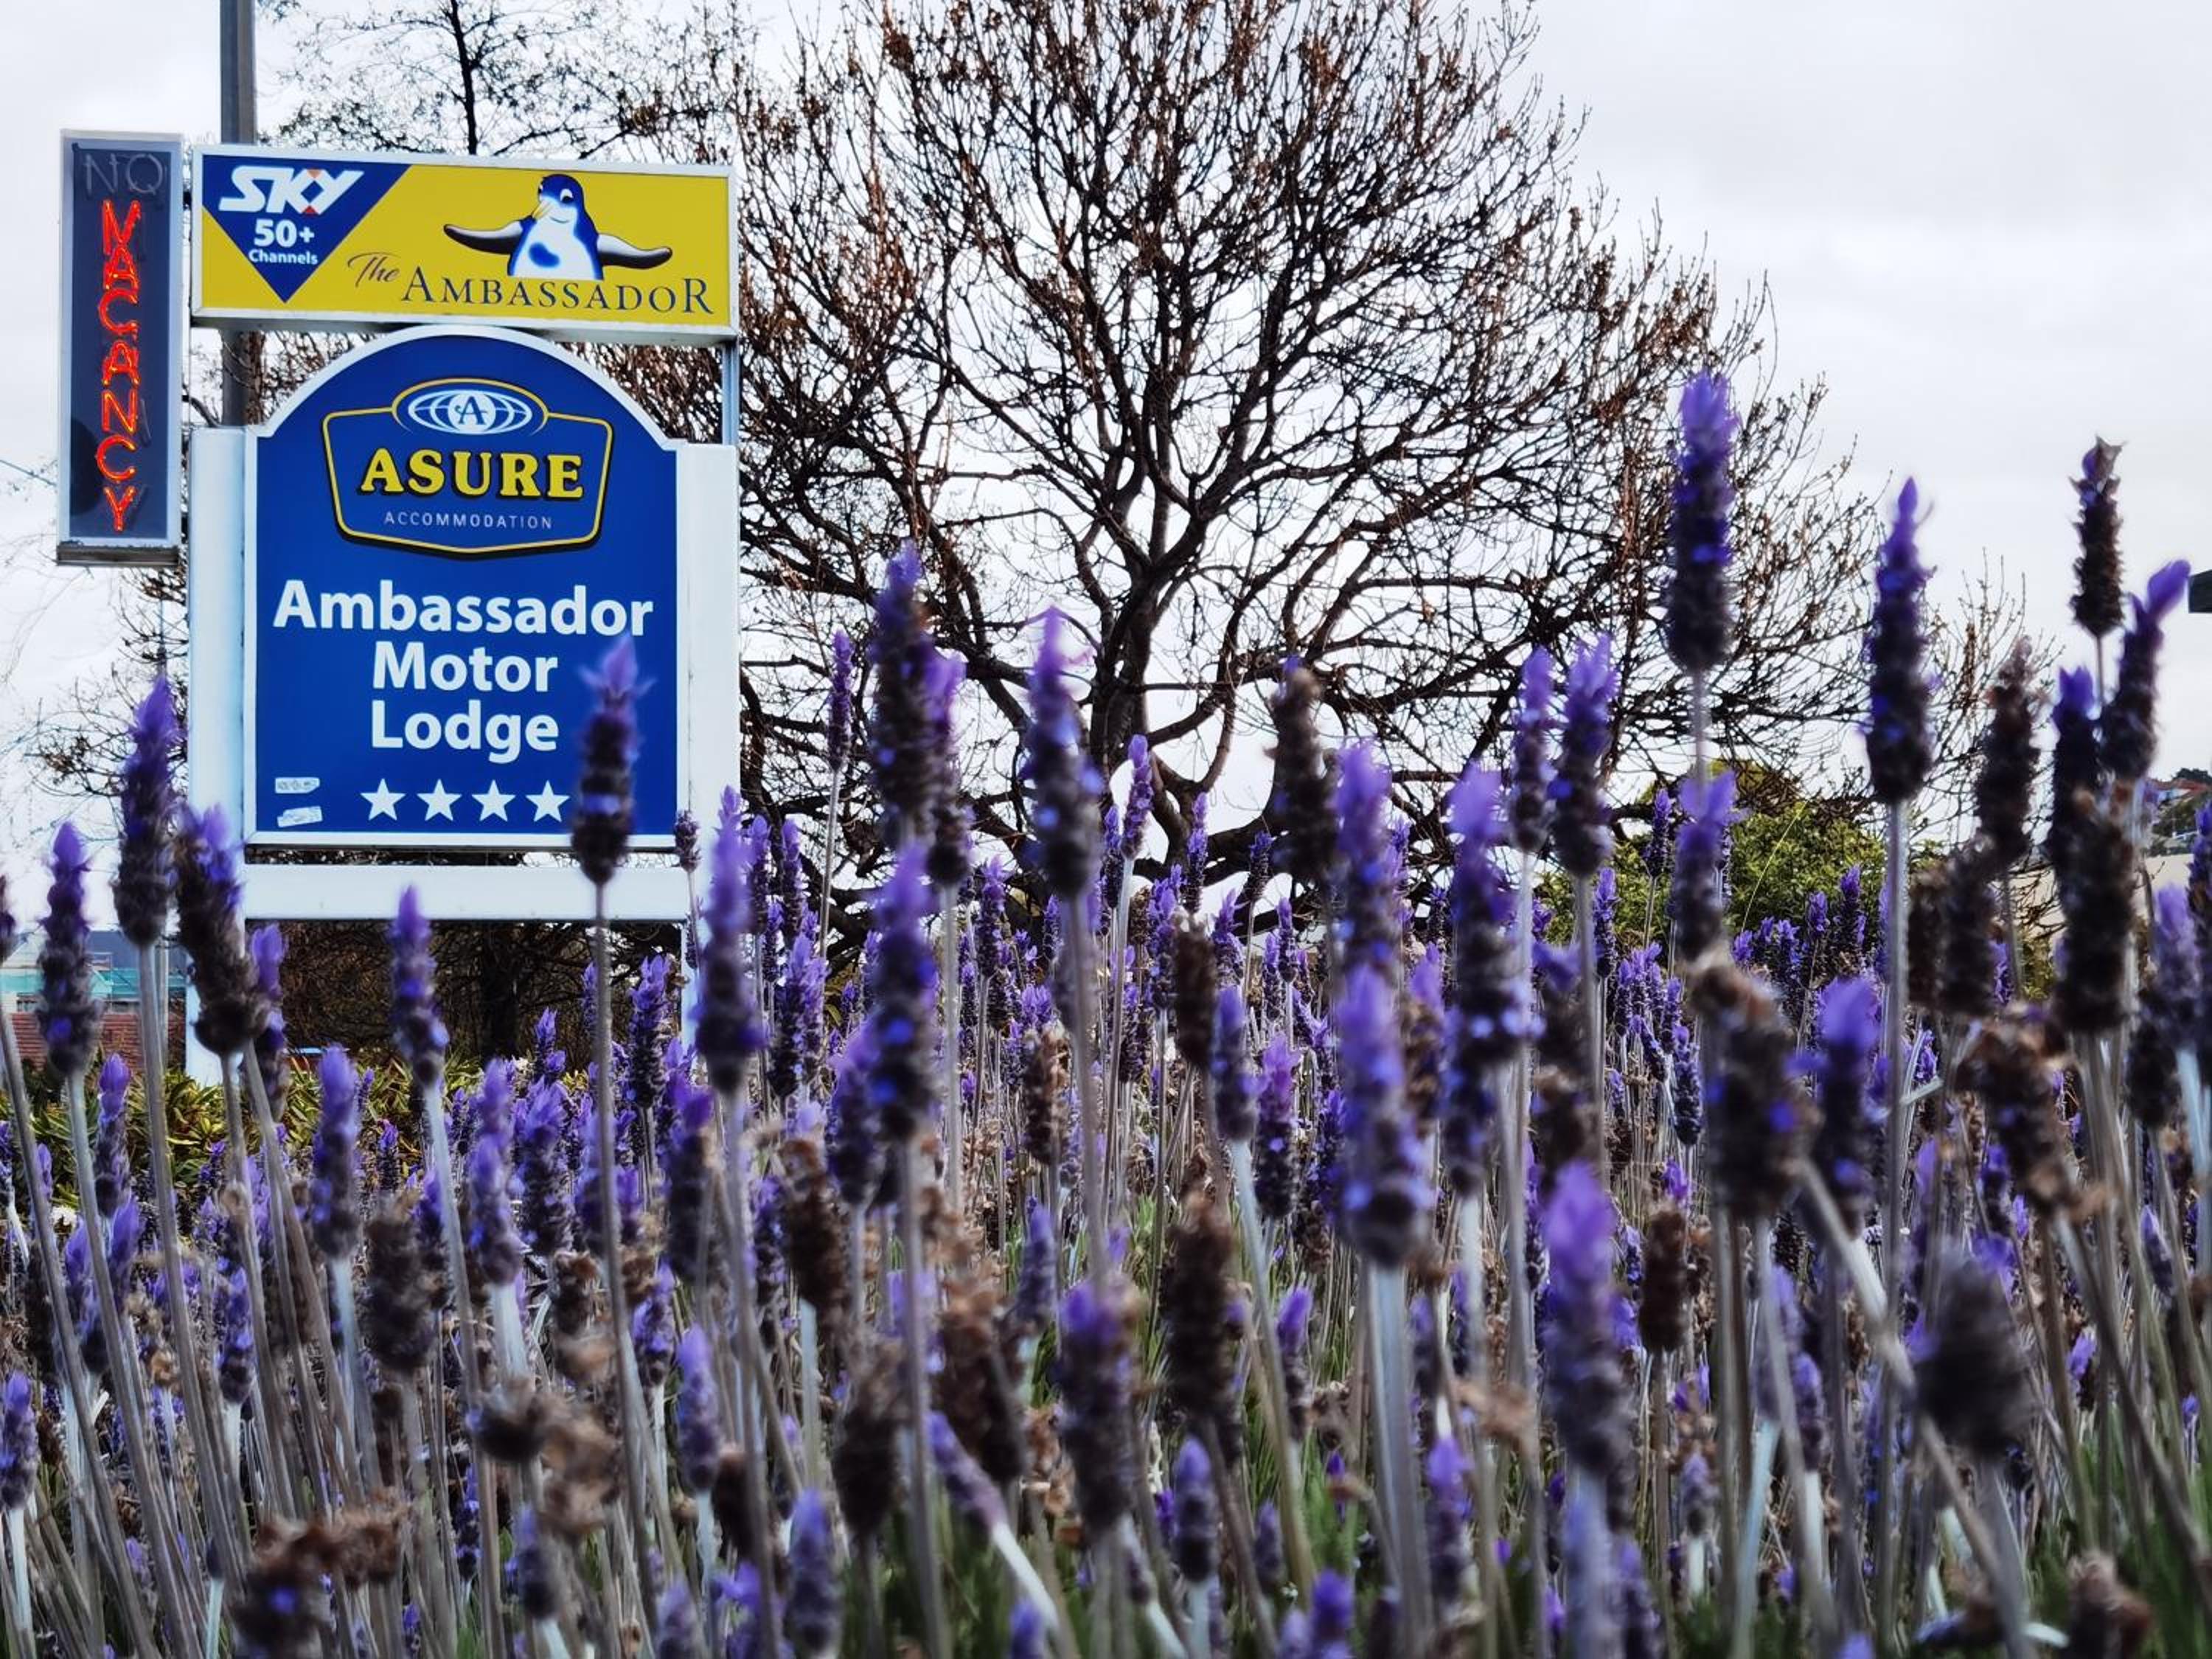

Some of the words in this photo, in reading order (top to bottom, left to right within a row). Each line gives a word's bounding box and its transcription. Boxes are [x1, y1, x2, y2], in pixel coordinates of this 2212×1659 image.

[83, 153, 164, 195] NO
[219, 166, 364, 215] SKY
[248, 248, 319, 265] Channels
[254, 219, 315, 248] 50+
[347, 252, 400, 288] The
[402, 266, 714, 314] AMBASSADOR
[97, 198, 141, 533] VACANCY
[360, 448, 584, 498] ASURE
[384, 512, 553, 530] ACCOMMODATION
[273, 580, 653, 636] Ambassador
[372, 641, 558, 692] Motor
[372, 700, 559, 763] Lodge
